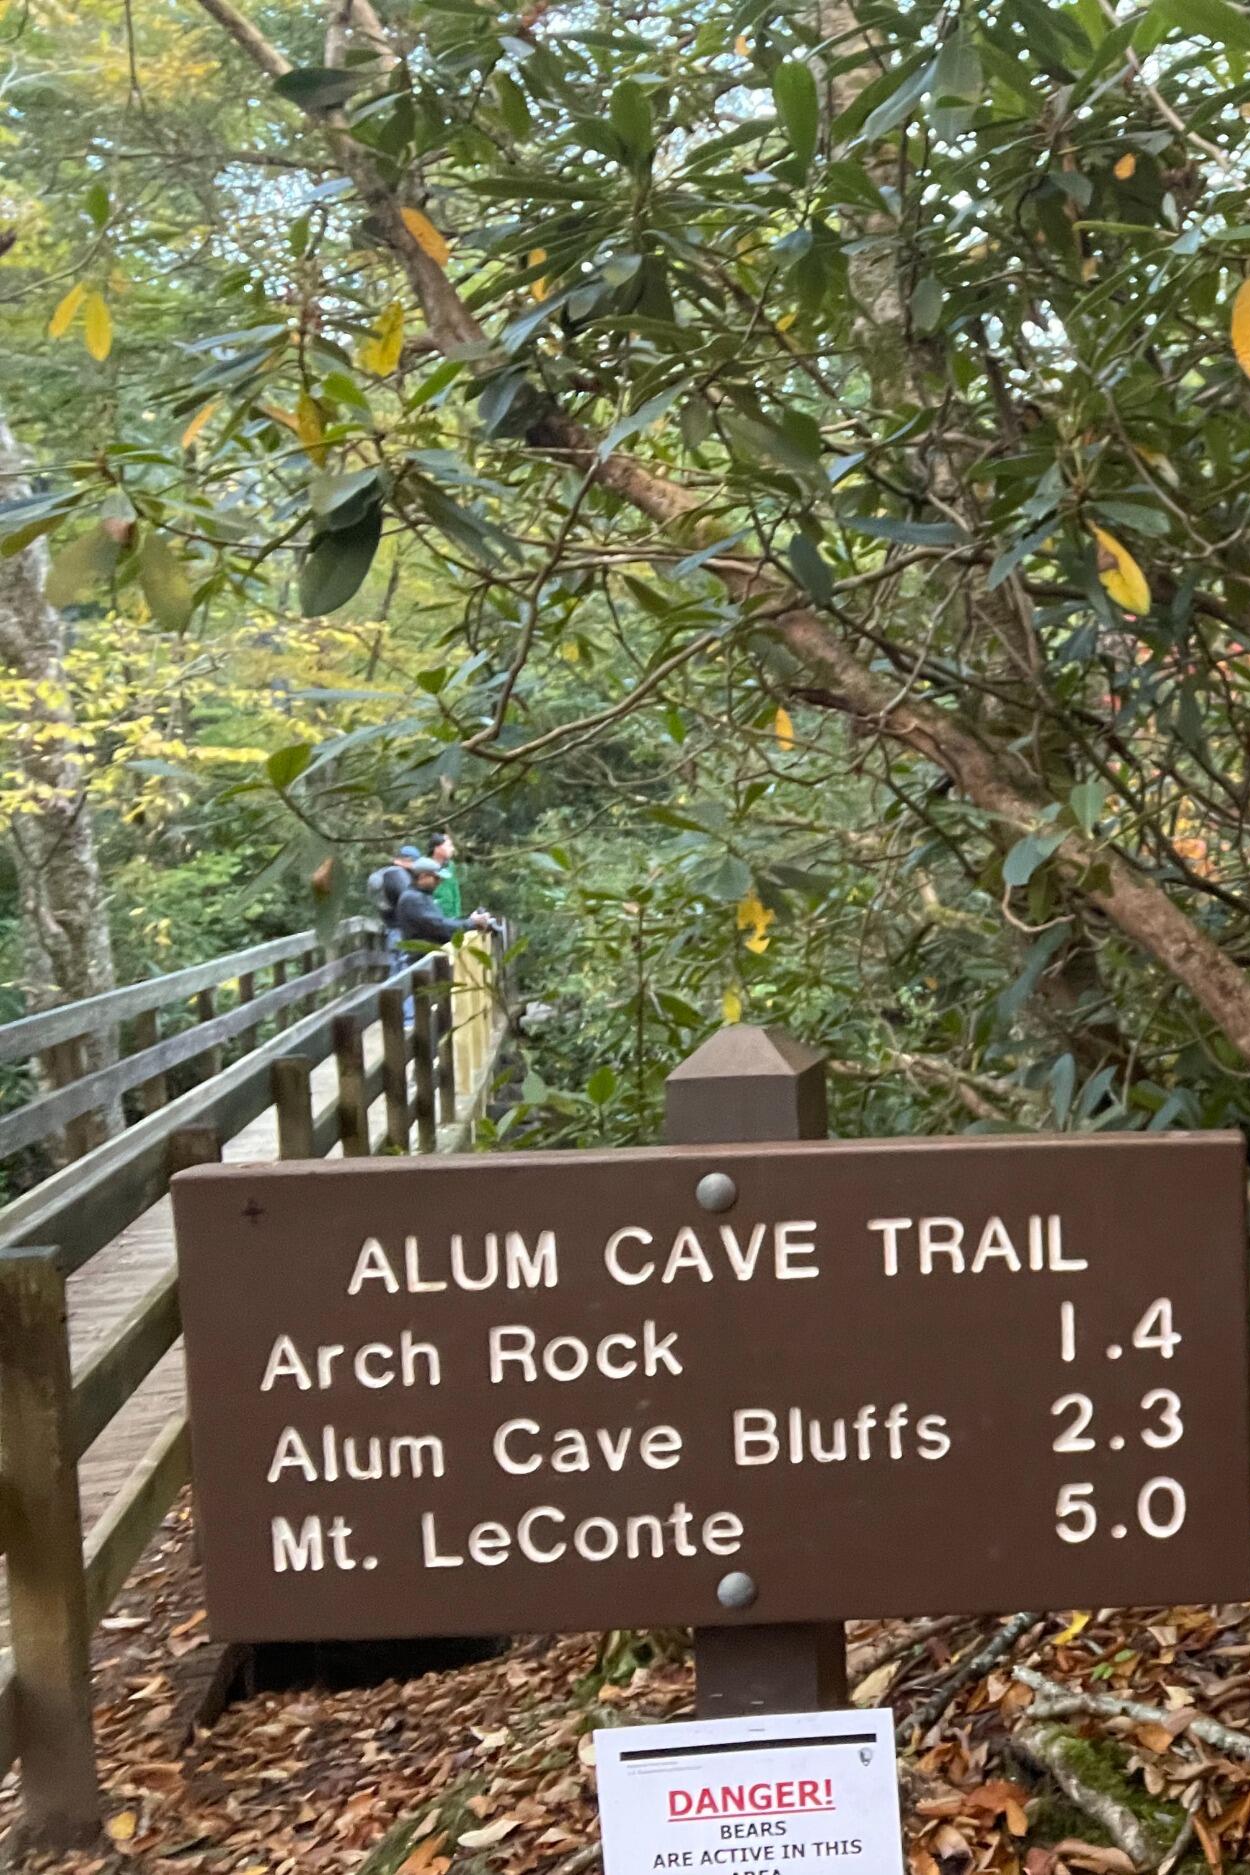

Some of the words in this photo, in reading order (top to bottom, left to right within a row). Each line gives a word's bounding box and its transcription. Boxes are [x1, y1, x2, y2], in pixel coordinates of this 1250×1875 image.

[347, 1230, 559, 1296] ALUM
[604, 1220, 820, 1286] CAVE
[867, 1214, 1089, 1277] TRAIL
[260, 1331, 441, 1392] Arch
[489, 1320, 684, 1384] Rock
[1061, 1297, 1182, 1362] 1.4
[267, 1425, 445, 1483] Alum
[493, 1418, 683, 1475] Cave
[734, 1402, 951, 1466] Bluffs
[1051, 1388, 1184, 1453] 2.3
[271, 1515, 379, 1573] Mt.
[422, 1502, 744, 1570] LeConte
[1055, 1476, 1186, 1544] 5.0
[667, 1778, 836, 1818] DANGER!
[720, 1820, 787, 1840] BEARS
[653, 1850, 694, 1870] ARE
[699, 1844, 775, 1866] ACTIVE
[782, 1842, 806, 1860] IN
[812, 1838, 863, 1858] THIS
